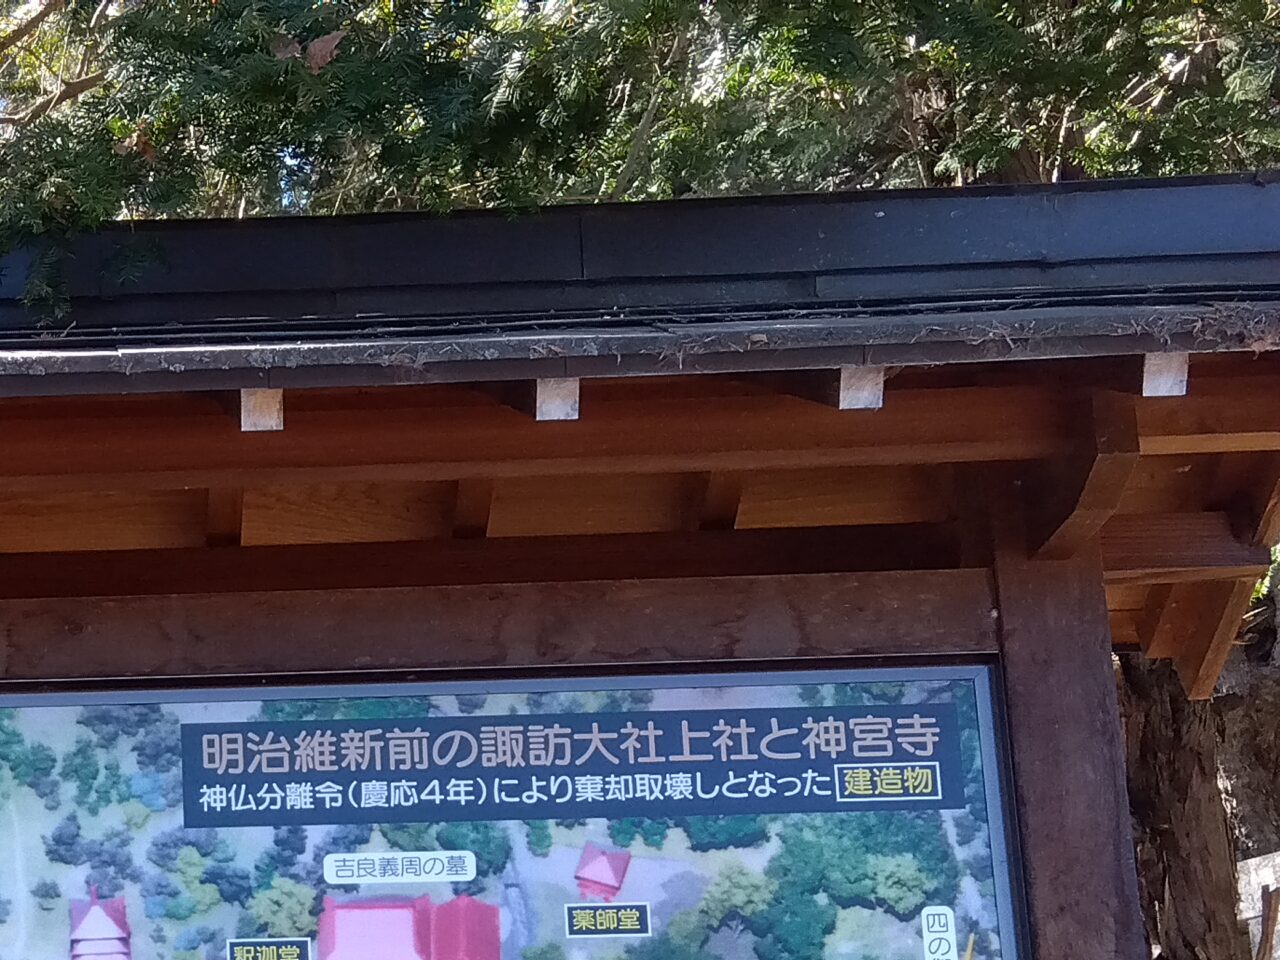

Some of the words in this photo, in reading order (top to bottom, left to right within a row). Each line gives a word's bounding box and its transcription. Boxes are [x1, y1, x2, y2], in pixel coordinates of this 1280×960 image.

[202, 714, 940, 775] 明治維新前の諏訪大社上社と神宮寺
[843, 768, 933, 796] 建造物
[334, 855, 468, 879] 吉良義周の墓
[573, 909, 641, 931] 薬師堂
